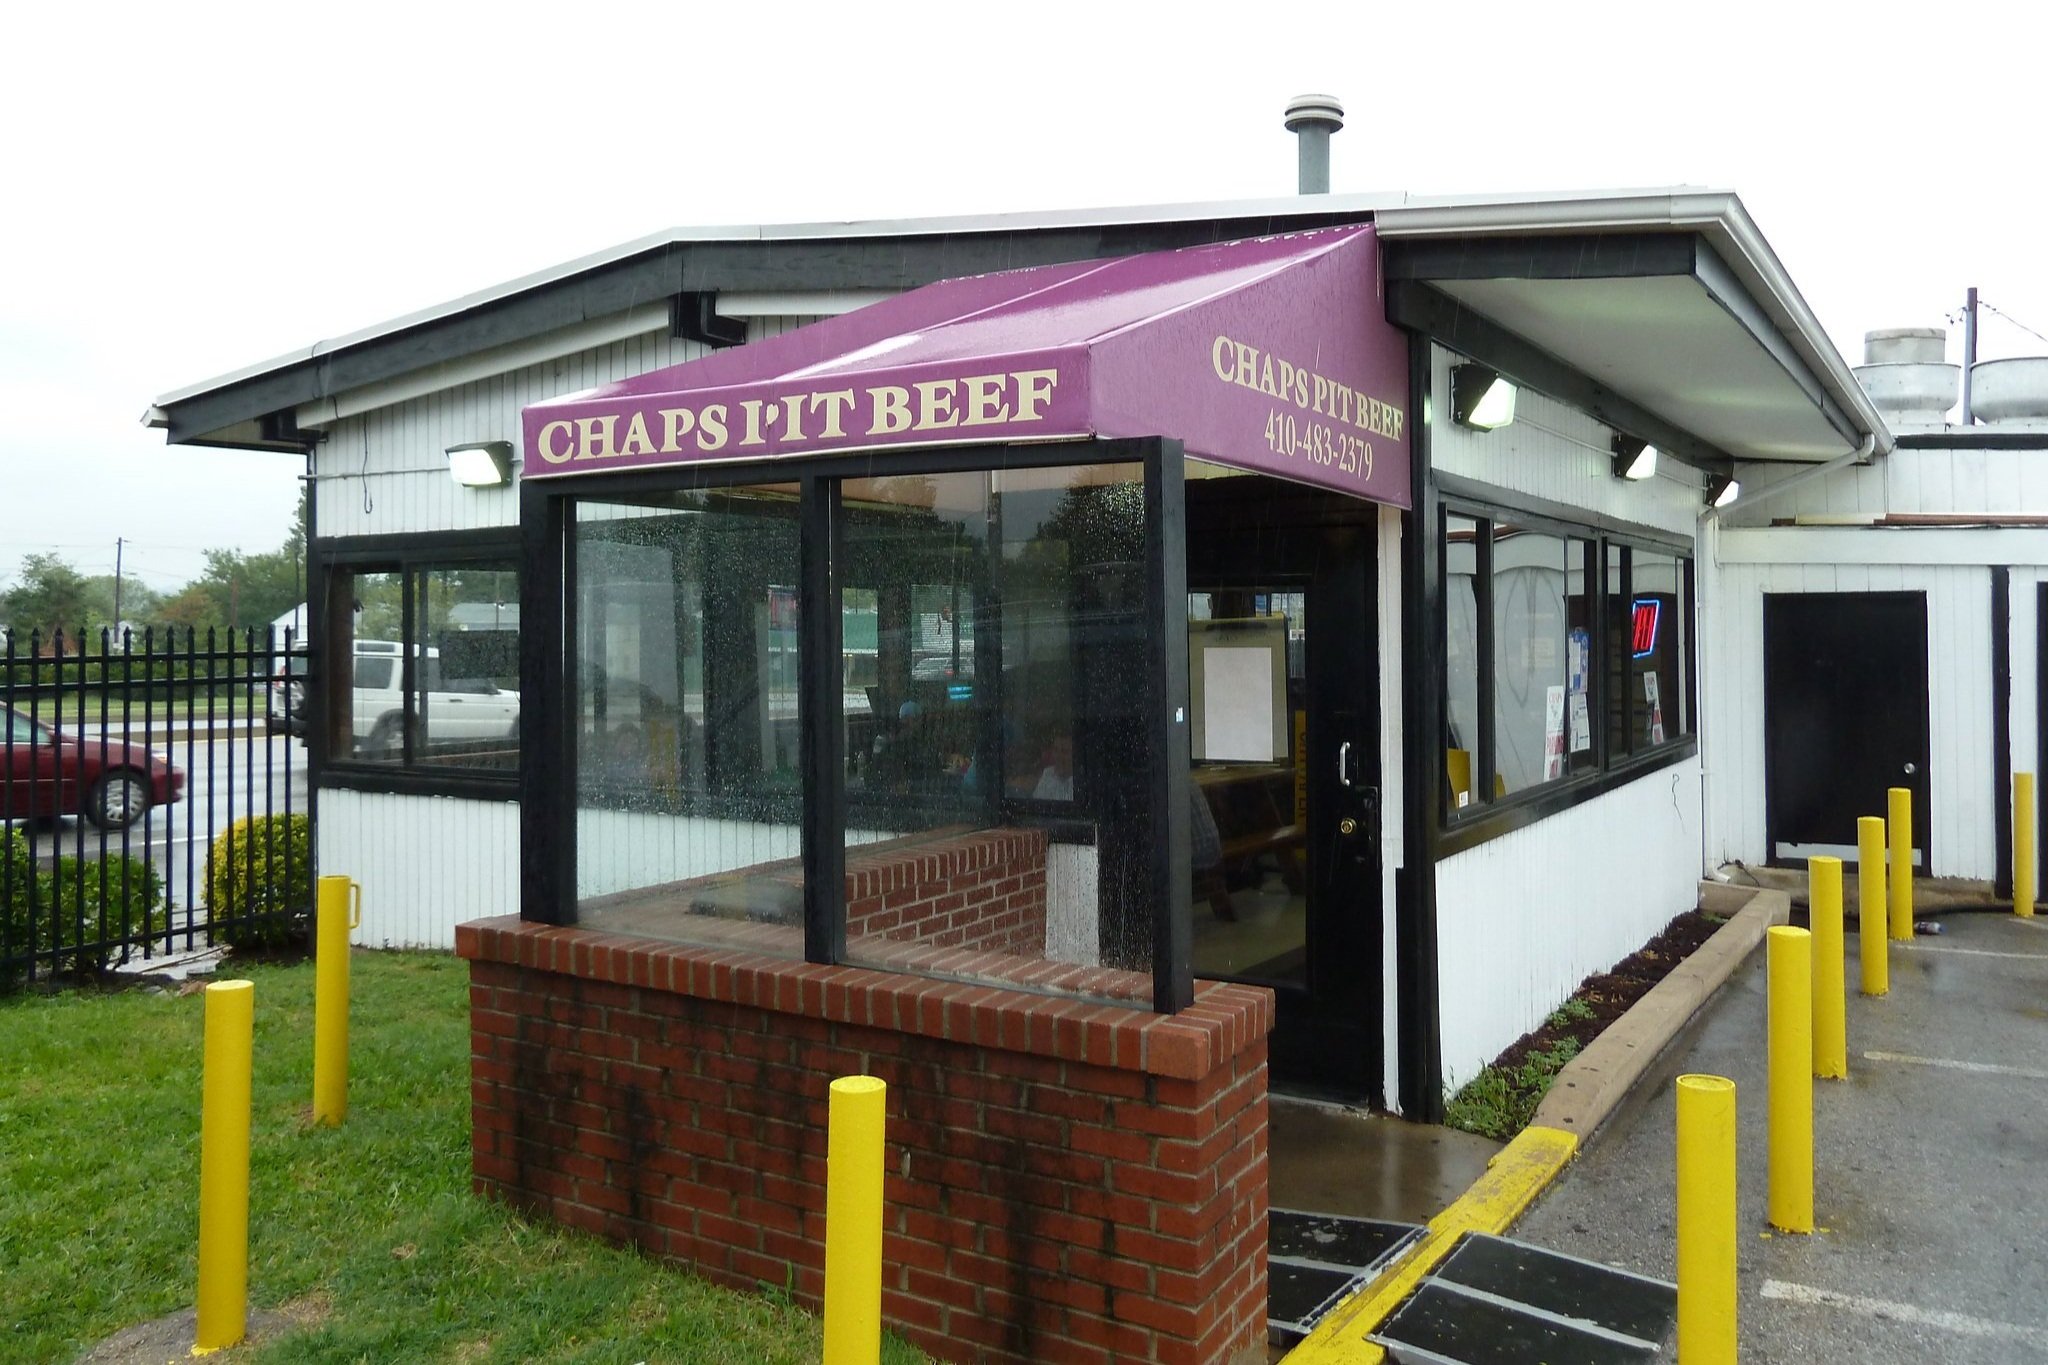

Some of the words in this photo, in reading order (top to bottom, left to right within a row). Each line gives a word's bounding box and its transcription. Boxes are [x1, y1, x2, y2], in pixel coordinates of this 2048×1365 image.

[538, 404, 729, 464] CHAPS
[739, 388, 856, 446] PIT
[865, 368, 1058, 436] BEEF
[1212, 335, 1309, 409] CHAPS
[1312, 373, 1353, 424] PIT
[1355, 391, 1404, 441] BEEF
[1264, 407, 1374, 482] 410-483-2379
